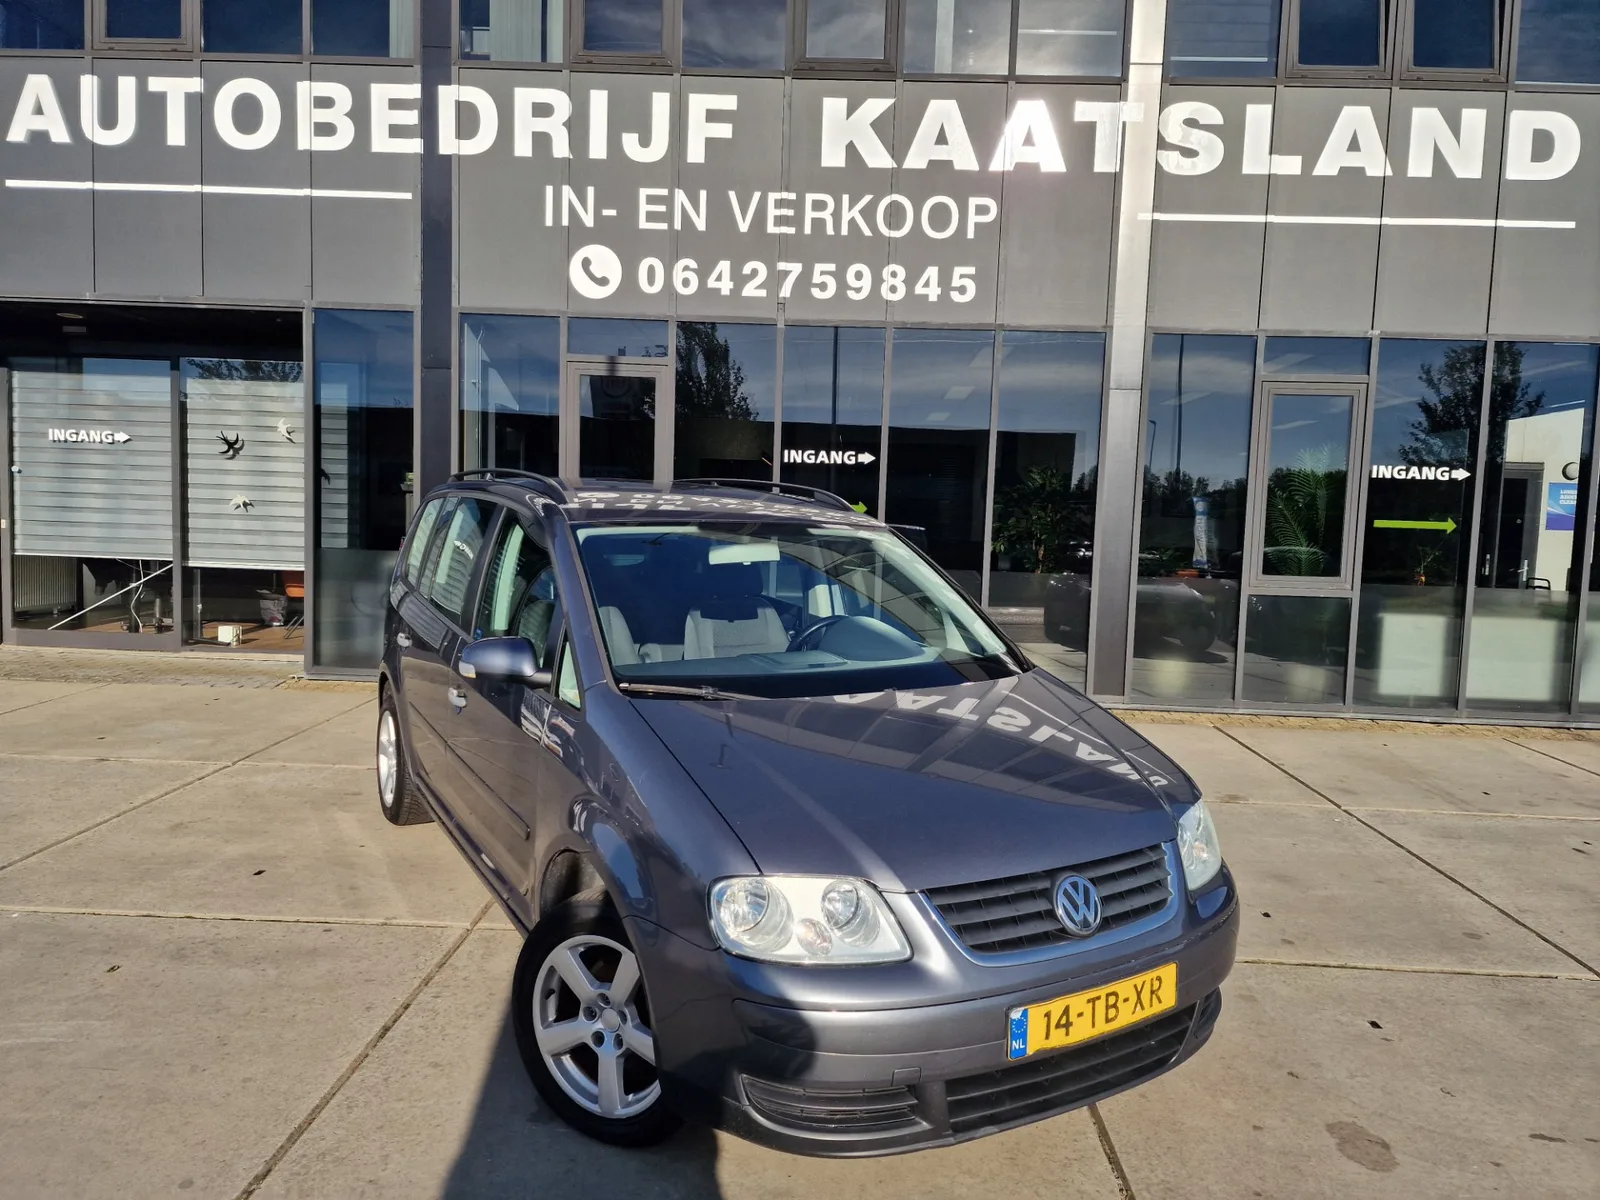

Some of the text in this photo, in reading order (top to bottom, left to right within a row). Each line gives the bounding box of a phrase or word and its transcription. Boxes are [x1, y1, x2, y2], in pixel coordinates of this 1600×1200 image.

[5, 73, 1582, 181] AUTOBEDRIJF KAATSLAND
[545, 184, 998, 240] IN- EN VERKOOP
[638, 256, 976, 303] 0642759845
[48, 428, 114, 443] INGANG
[783, 449, 856, 465] INGANG
[1371, 464, 1450, 481] INGANG
[1043, 975, 1163, 1040] 14-TB-XR
[1012, 1039, 1025, 1050] NL
